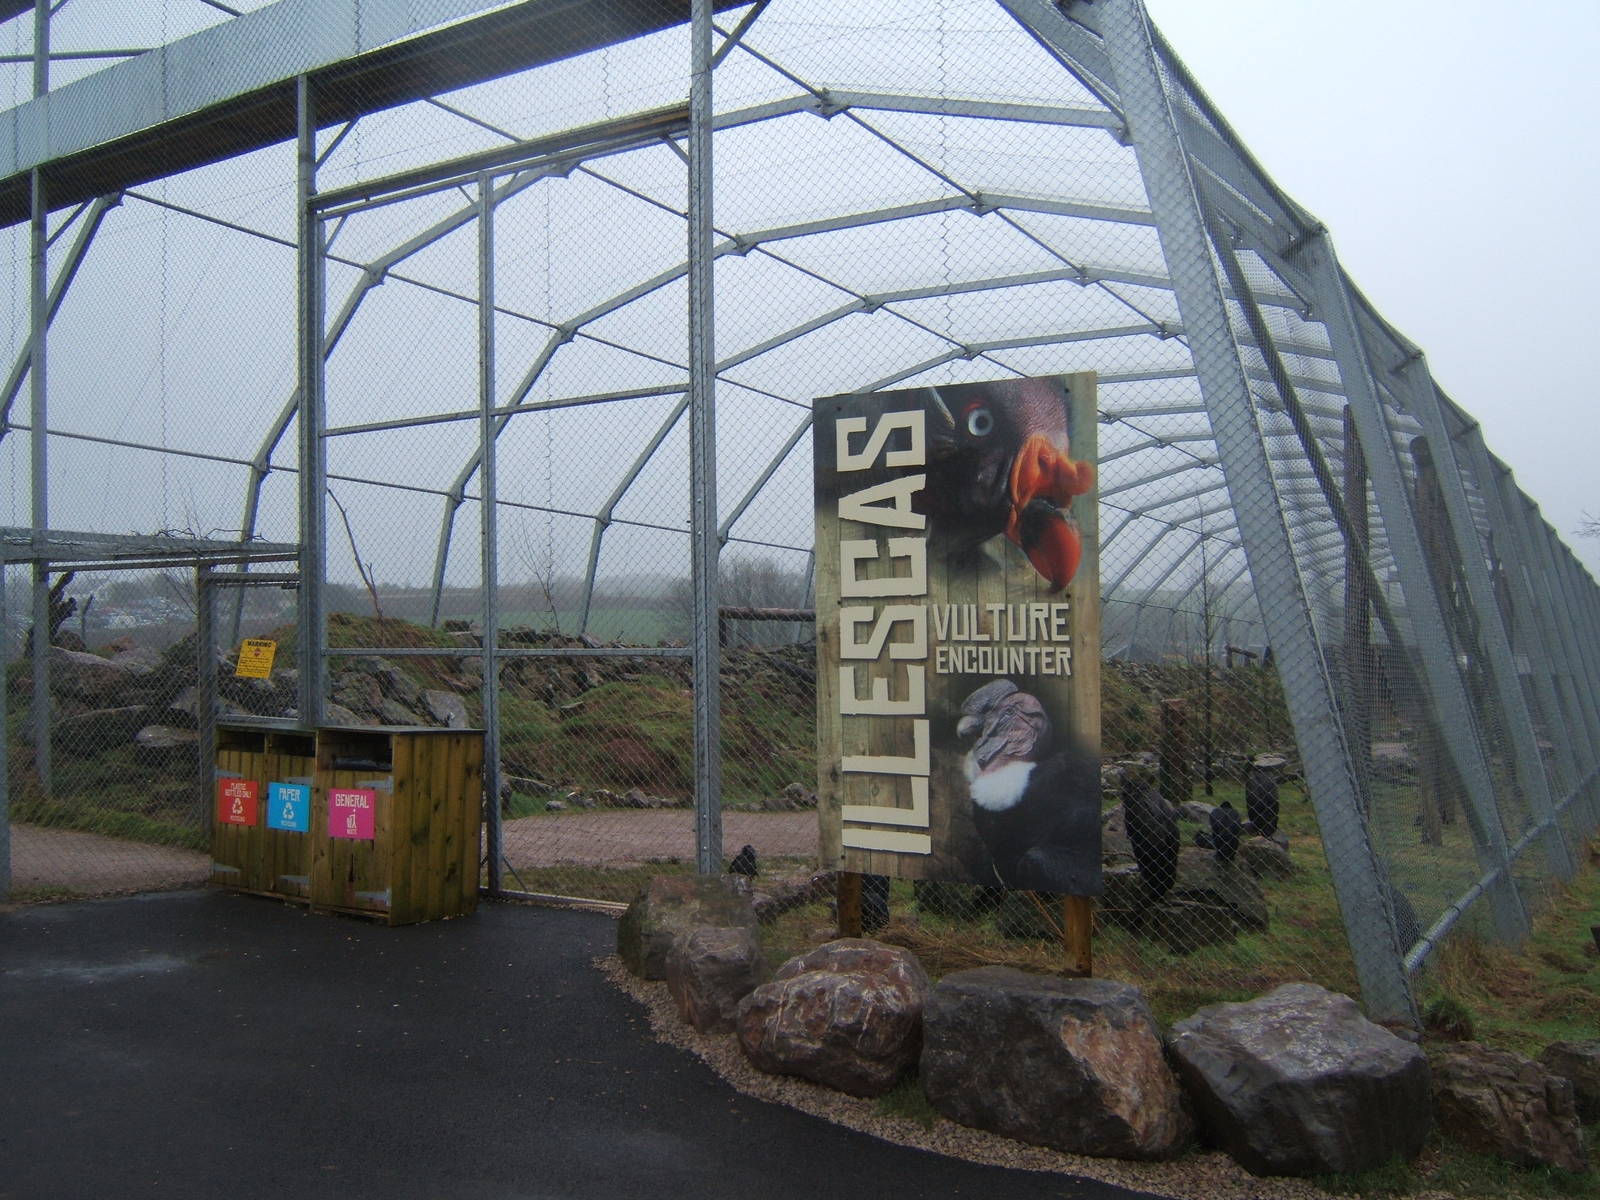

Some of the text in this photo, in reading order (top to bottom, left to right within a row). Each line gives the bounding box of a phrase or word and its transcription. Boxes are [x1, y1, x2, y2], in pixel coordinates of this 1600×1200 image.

[836, 409, 931, 854] ILLESCAS
[933, 603, 1070, 641] VULTURE
[936, 646, 1071, 676] ENCOUNTER
[279, 787, 301, 802] PAPER
[335, 793, 370, 808] GENERAL
